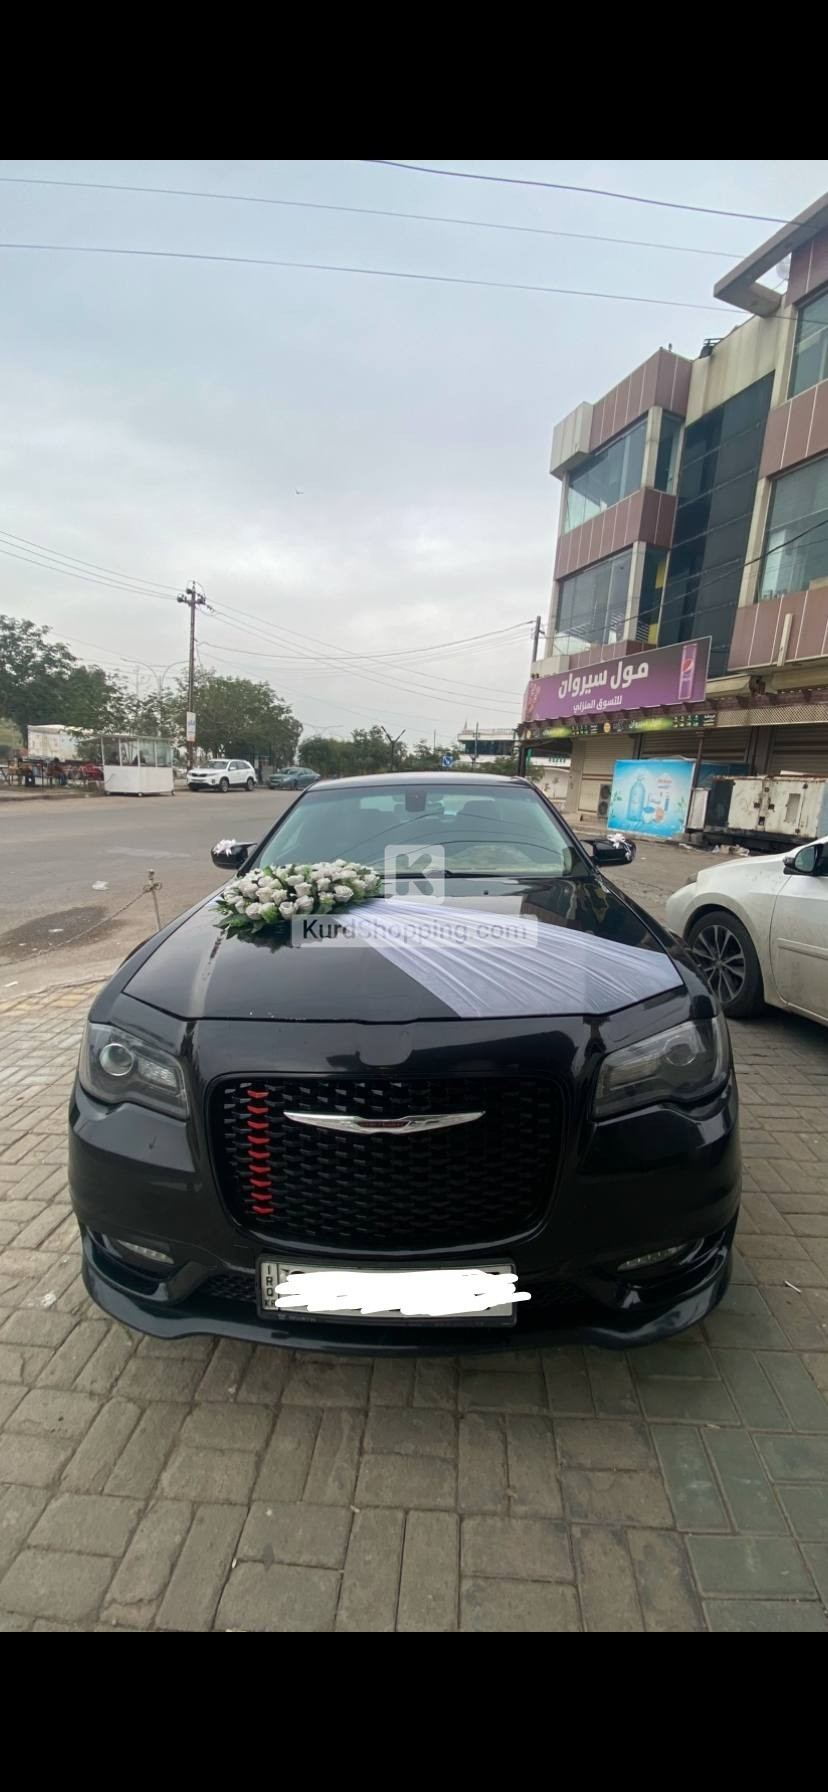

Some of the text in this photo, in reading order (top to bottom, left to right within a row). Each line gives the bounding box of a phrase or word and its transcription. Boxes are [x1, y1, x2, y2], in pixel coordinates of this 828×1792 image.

[558, 661, 649, 699] مول سيروان
[573, 695, 623, 713] للتسوق المنزلي
